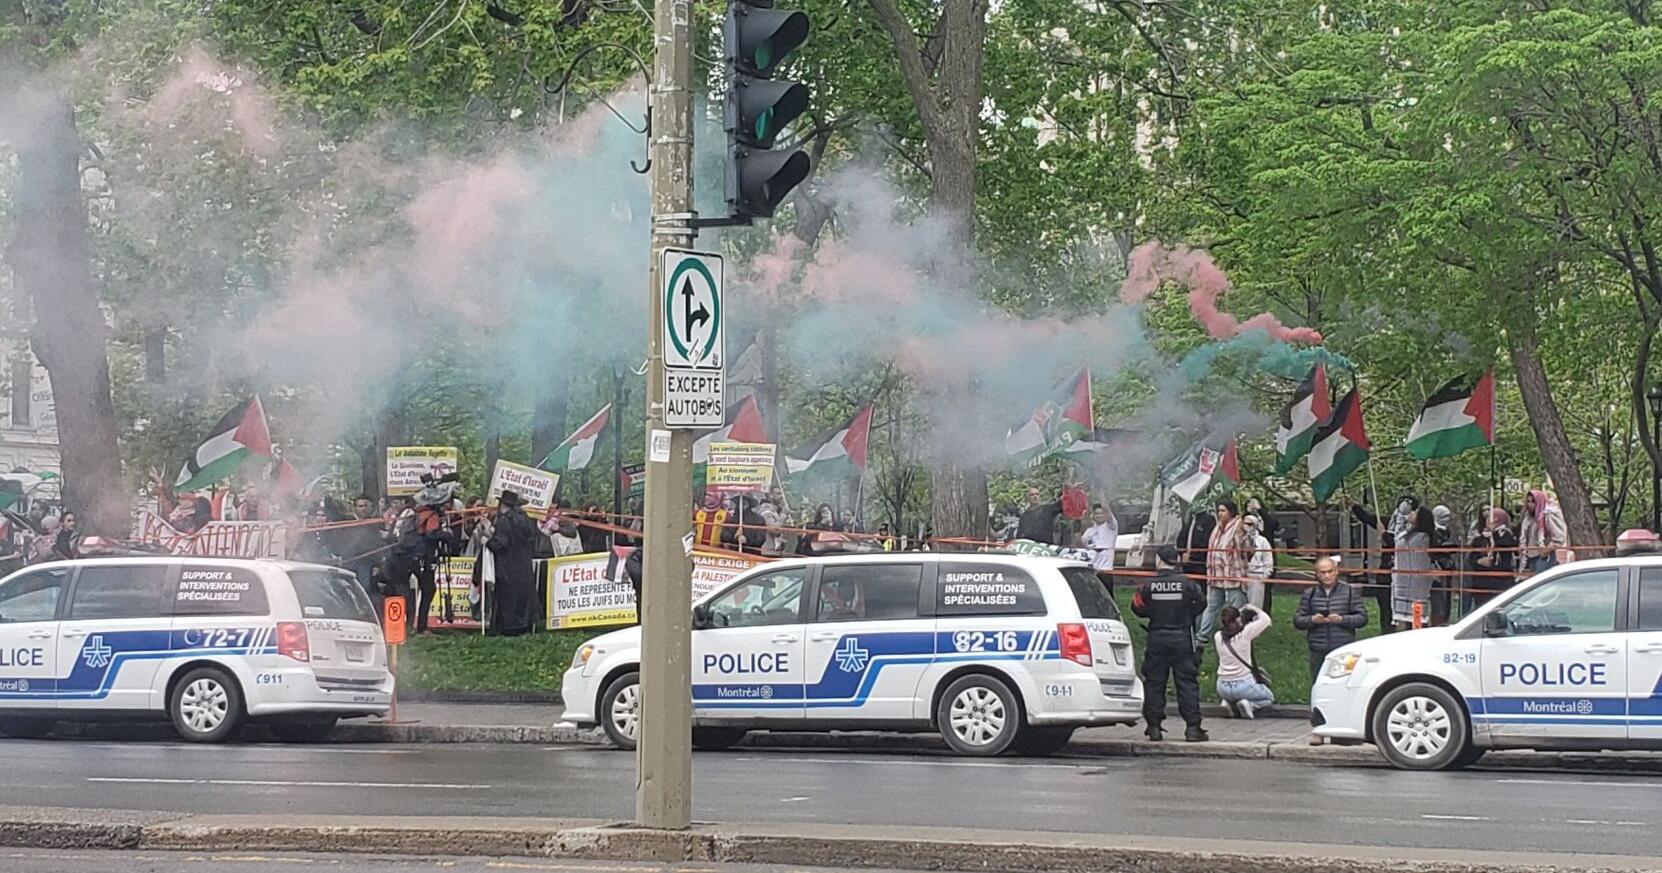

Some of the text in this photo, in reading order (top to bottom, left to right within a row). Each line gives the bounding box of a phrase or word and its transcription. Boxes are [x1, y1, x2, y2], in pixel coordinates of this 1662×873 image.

[667, 399, 721, 416] AUTOBS
[717, 559, 750, 569] EXIGE
[182, 571, 232, 580] SUPPORT &
[946, 573, 1004, 582] SUPPORT &
[180, 581, 249, 590] INTERVENTIONS
[568, 585, 578, 597] NE
[944, 583, 1026, 593] INTERVENTIONS
[1151, 582, 1182, 592] POLICE
[177, 591, 240, 600] SPÉCIALISÉES
[944, 593, 1017, 605] SPÉCIALISÉES
[557, 597, 577, 610] TOUS
[577, 597, 591, 608] LES
[592, 595, 613, 606] JUIFS
[614, 594, 625, 605] DU
[202, 629, 249, 647] 72-7
[954, 630, 1018, 652] 82-16
[0, 648, 44, 667] LICE
[703, 652, 789, 674] POLICE
[1444, 652, 1476, 663] 82-19
[1500, 663, 1607, 686] POLICE
[718, 687, 760, 697] Montréal
[1523, 701, 1577, 713] Montréal
